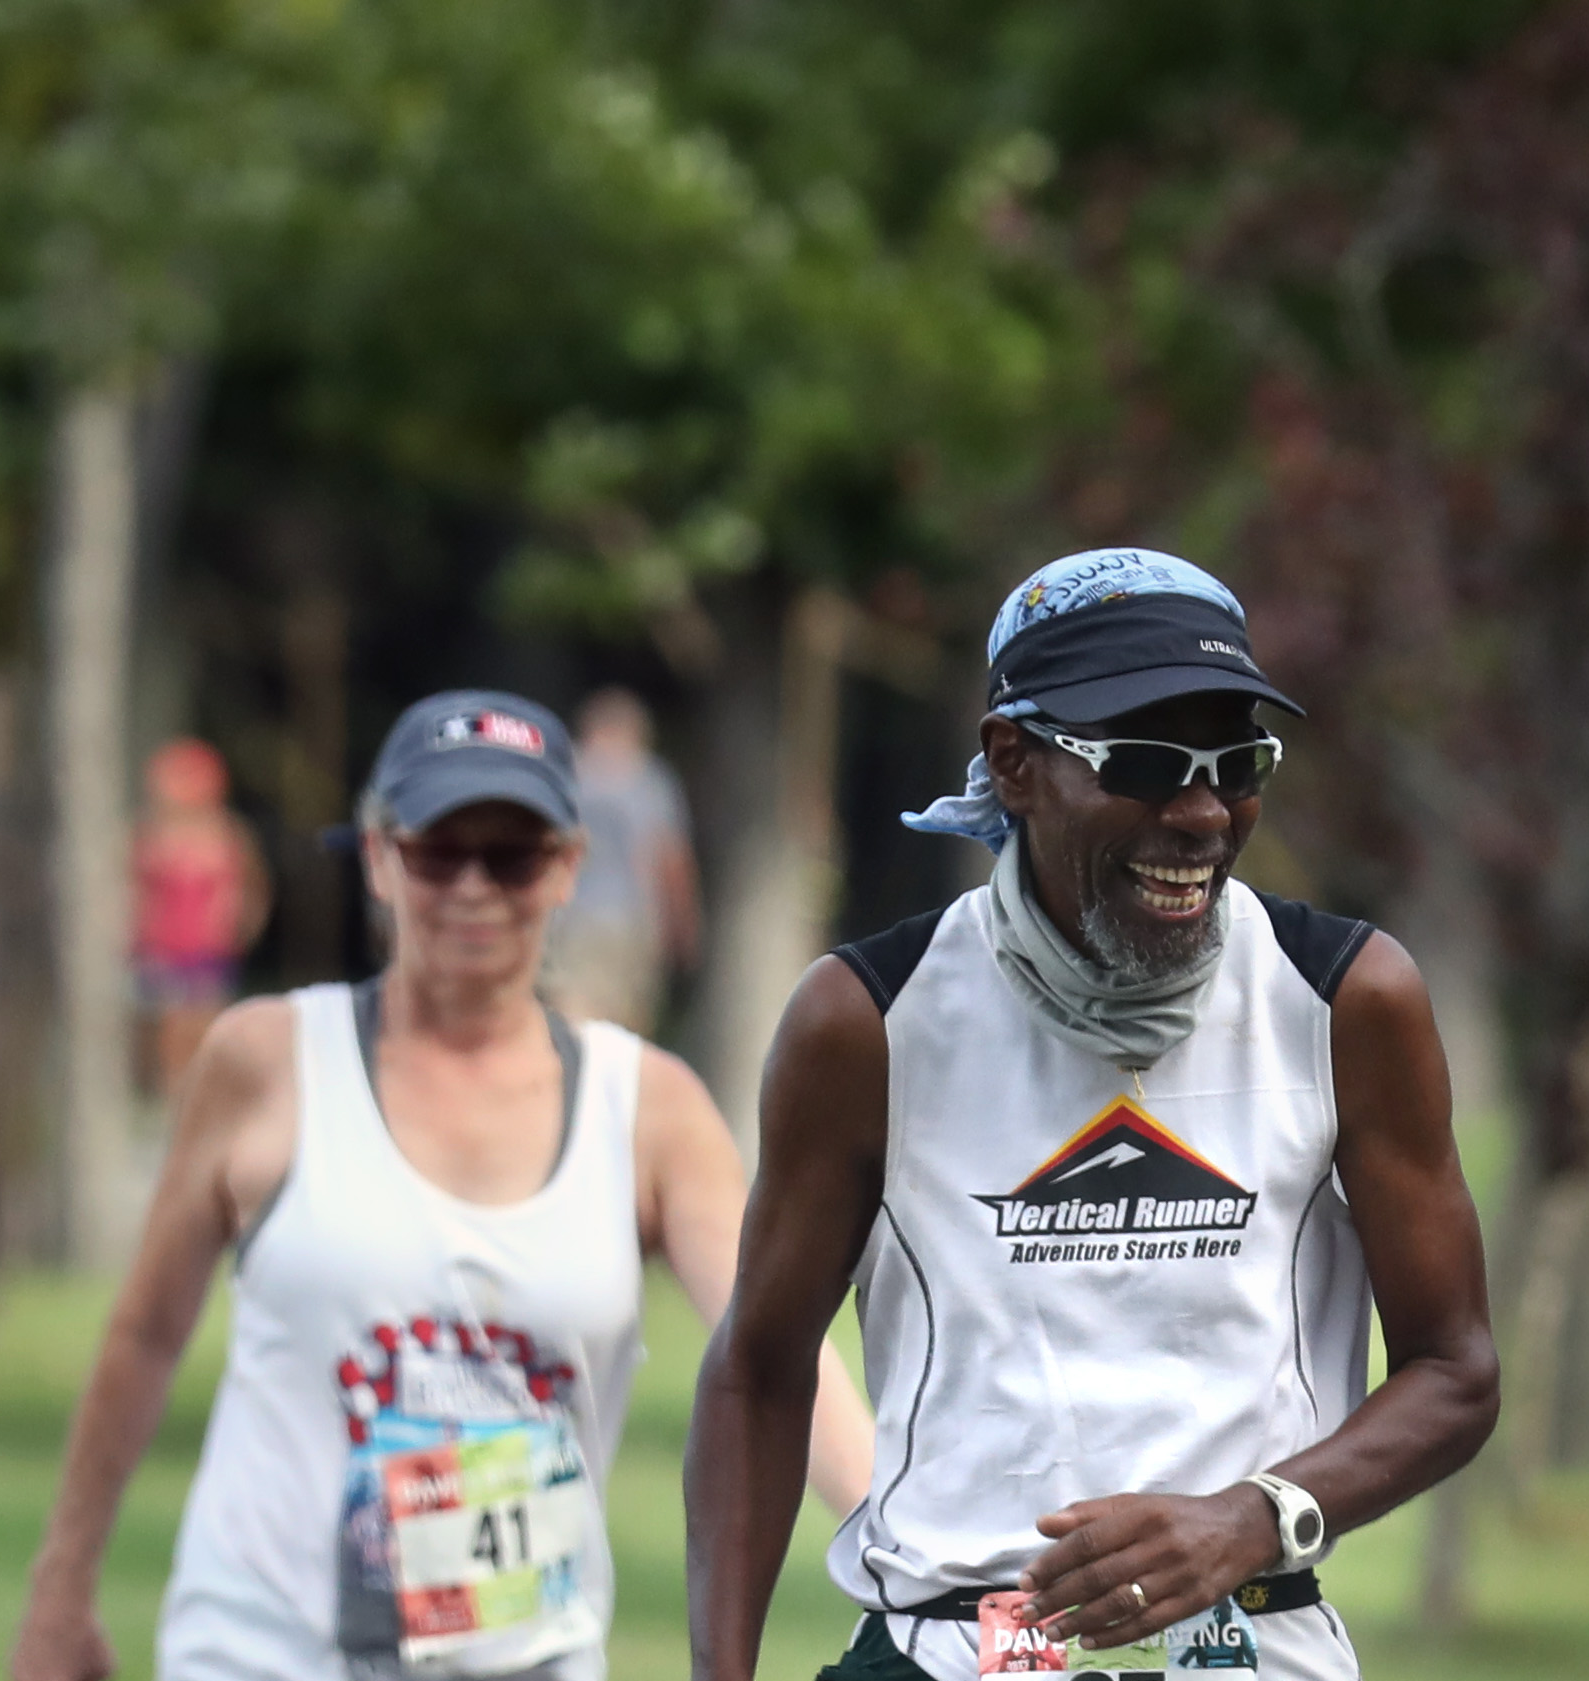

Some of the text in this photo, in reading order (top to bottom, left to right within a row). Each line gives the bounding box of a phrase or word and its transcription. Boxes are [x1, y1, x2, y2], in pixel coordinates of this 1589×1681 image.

[999, 1194, 1251, 1232] Vertical Runner
[1010, 1236, 1241, 1264] Adventure Starts Here
[471, 1502, 530, 1574] 41
